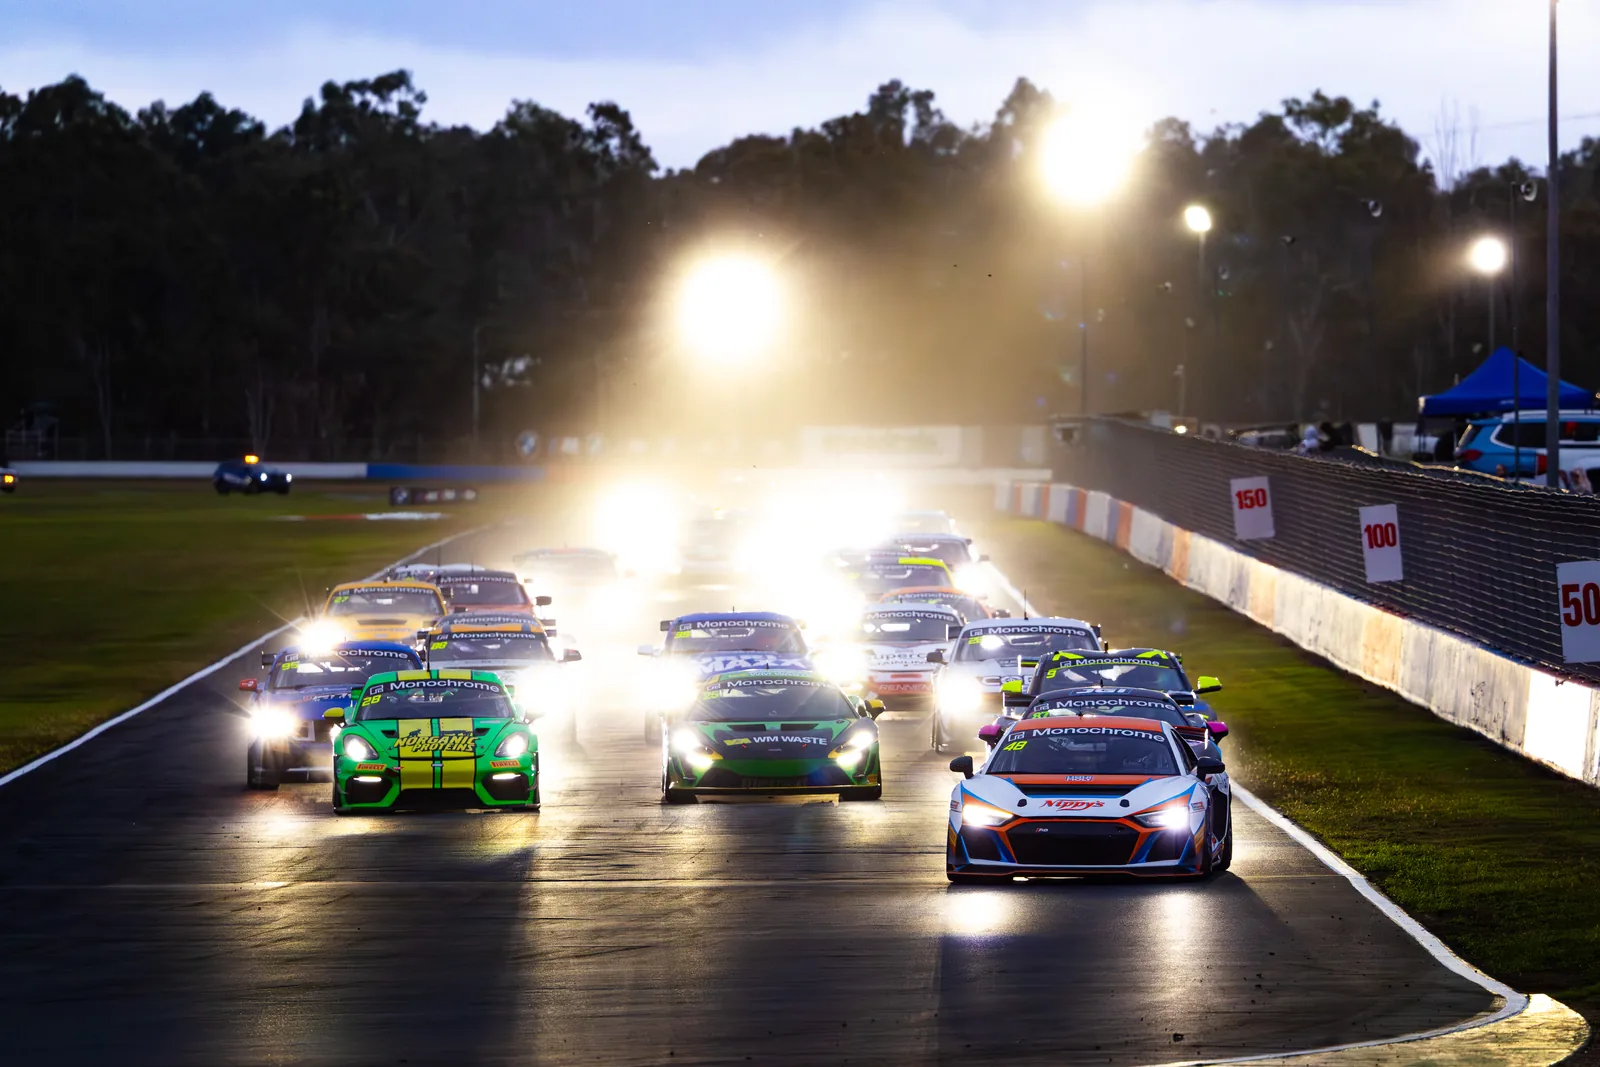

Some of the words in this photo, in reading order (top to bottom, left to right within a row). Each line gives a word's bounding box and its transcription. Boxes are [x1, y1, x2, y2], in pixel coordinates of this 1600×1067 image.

[1235, 488, 1267, 510] 150
[1364, 522, 1397, 549] 100
[353, 586, 434, 595] Monochrome
[1561, 582, 1600, 627] 50
[867, 610, 954, 621] Monochrome
[697, 620, 789, 629] Monochrome
[988, 625, 1086, 636] Monochrome
[304, 648, 408, 659] Mochrome
[1075, 657, 1160, 667] Monochrome
[1046, 668, 1057, 679] 9
[390, 679, 500, 693] Monochrome
[727, 678, 837, 689] Monochrome
[361, 694, 382, 707] 28
[1056, 699, 1176, 711] Monochrome
[1032, 727, 1165, 743] Monochrome
[781, 736, 828, 746] WASTE
[1003, 740, 1028, 752] 48
[1040, 799, 1105, 812] Nippy's
